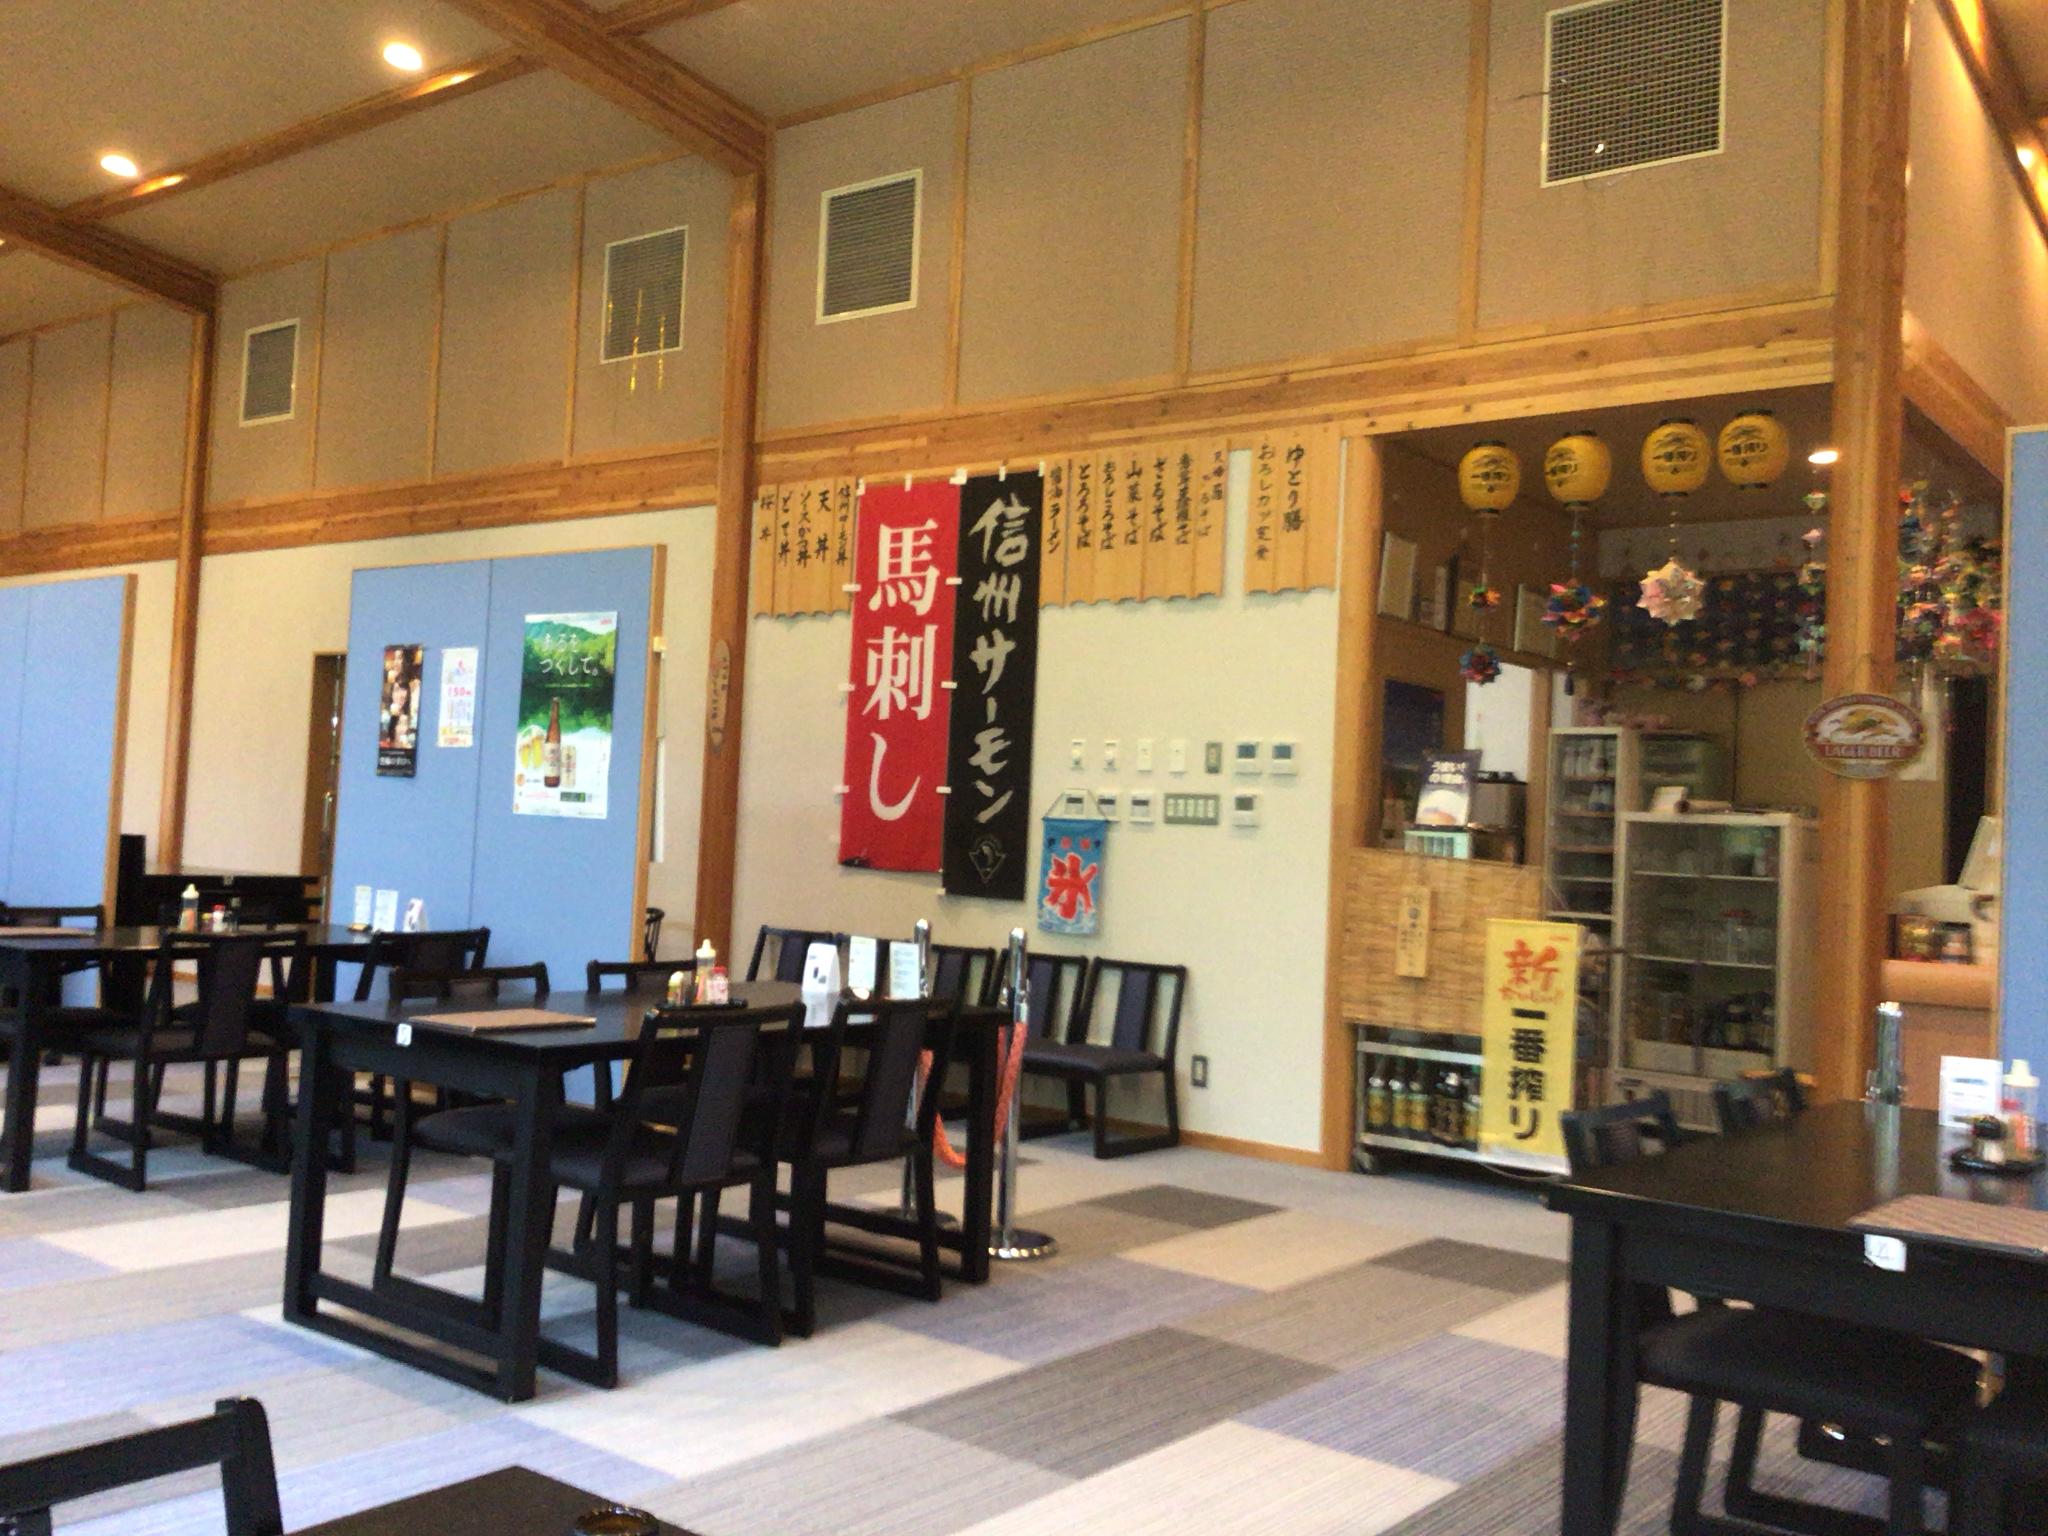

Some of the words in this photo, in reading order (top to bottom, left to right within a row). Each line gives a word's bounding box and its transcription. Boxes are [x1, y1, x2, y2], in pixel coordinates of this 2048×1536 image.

[796, 490, 811, 568] ソースかつ丼
[815, 489, 831, 562] 天丼
[861, 518, 939, 822] 馬刺し
[968, 494, 1031, 823] 信州サーモン
[1043, 851, 1099, 921] 氷
[1503, 938, 1561, 991] 新
[1508, 1006, 1548, 1140] 一番搾り
